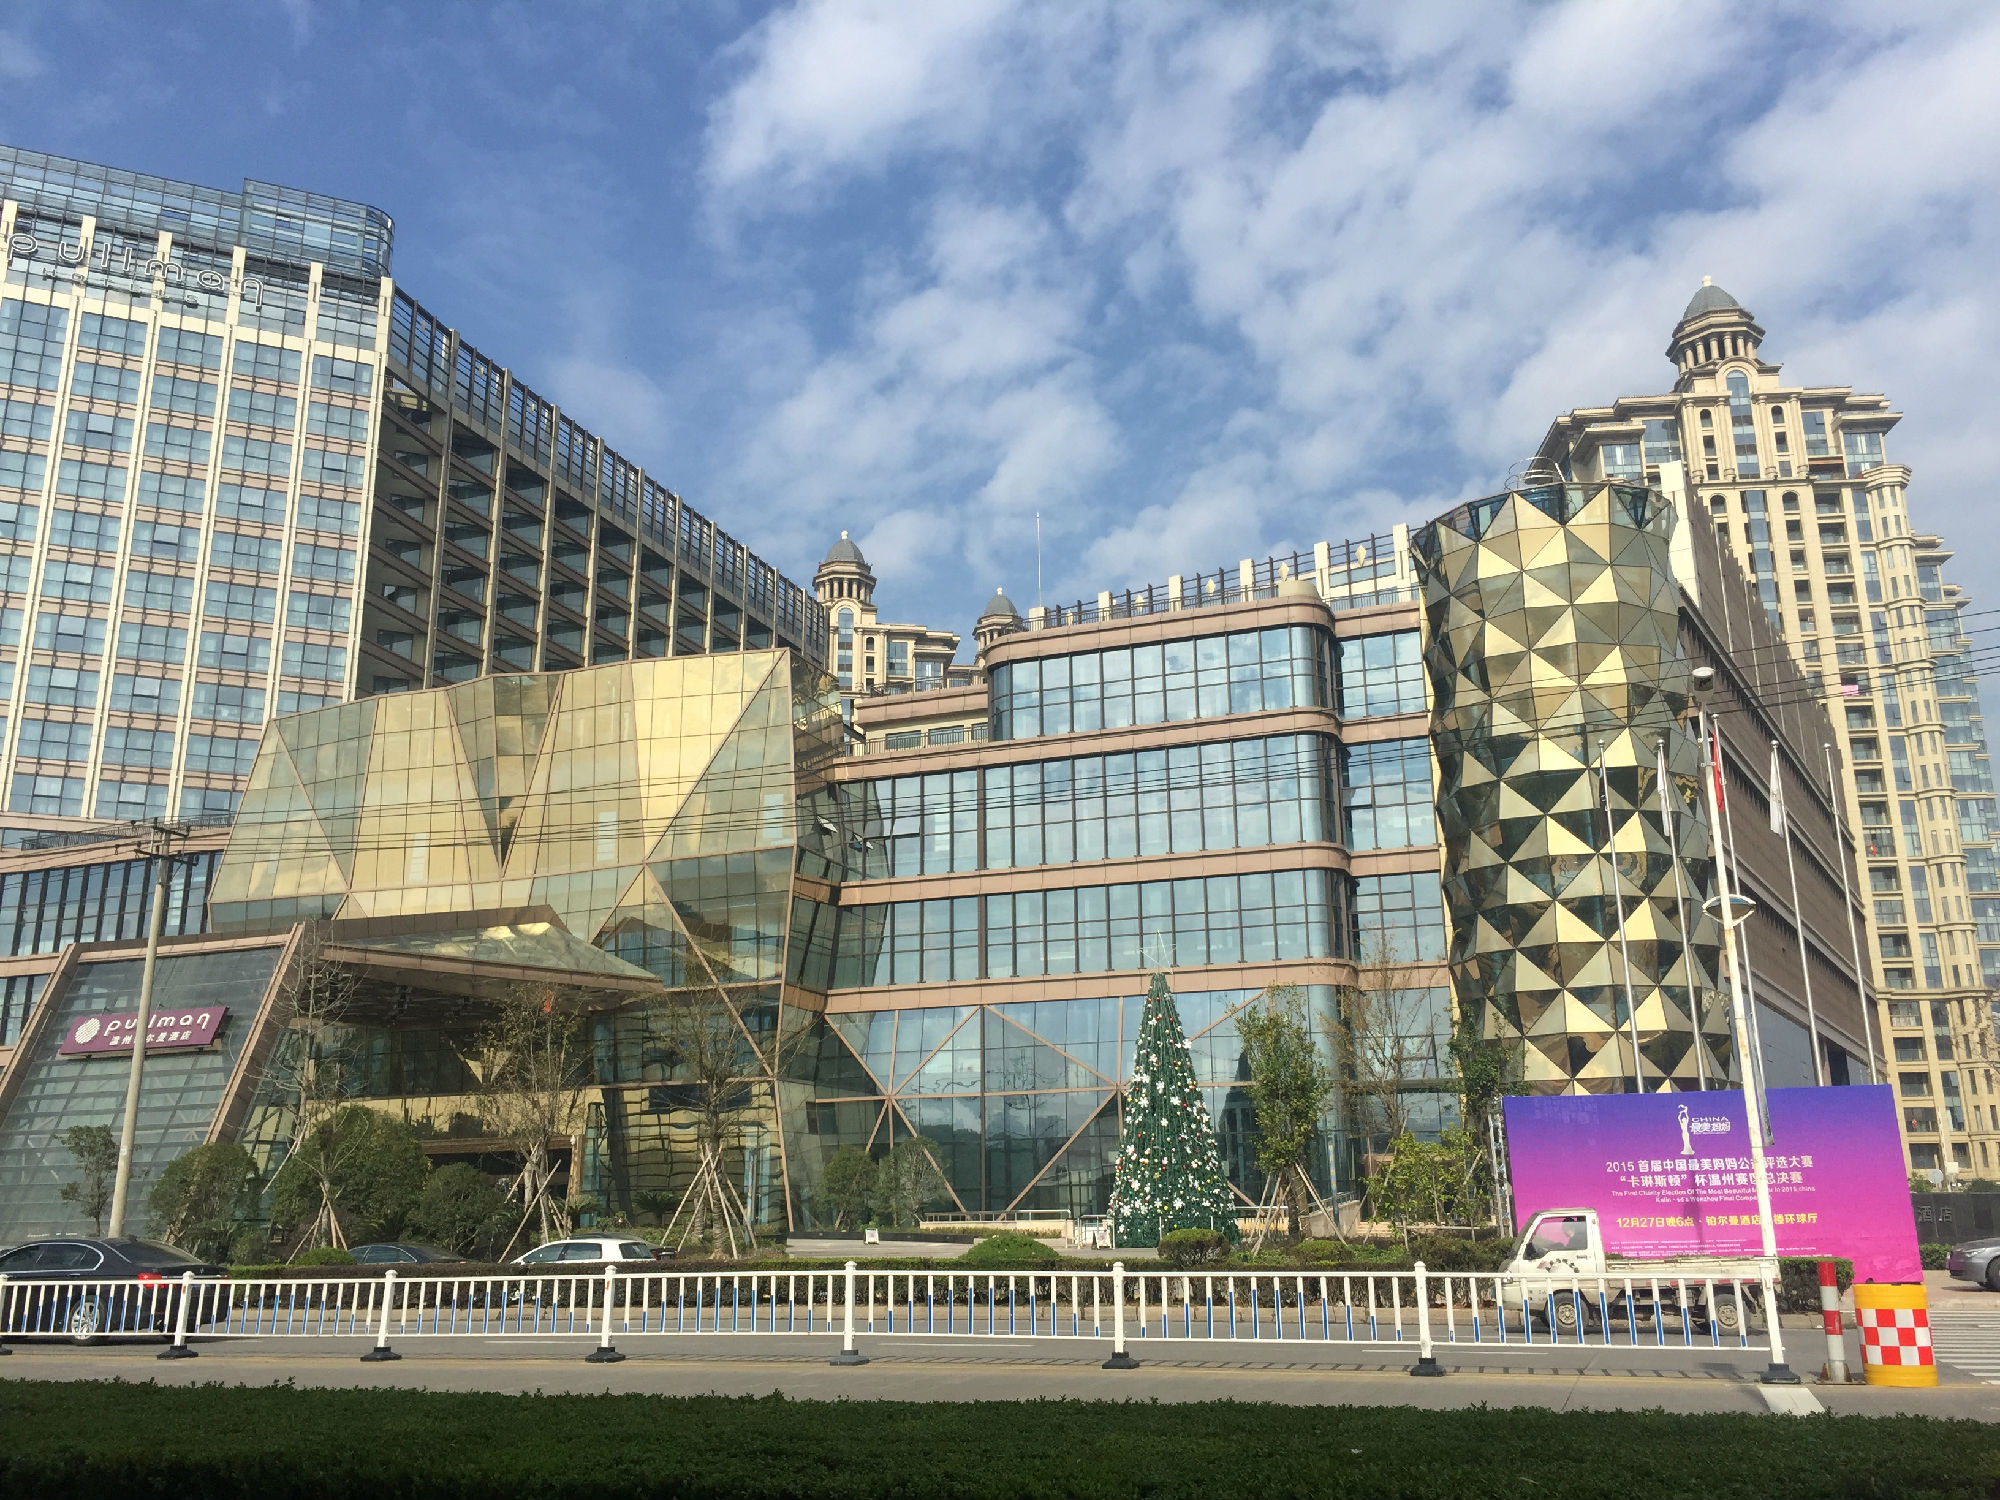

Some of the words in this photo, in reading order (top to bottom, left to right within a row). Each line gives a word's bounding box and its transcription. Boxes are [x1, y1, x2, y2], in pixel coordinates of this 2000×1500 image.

[7, 233, 264, 308] pullman
[103, 1013, 210, 1036] pulman
[109, 1030, 192, 1046] 温州尔曼酒店
[1606, 1161, 1635, 1173] 2015
[1918, 1205, 1953, 1222] 酒店
